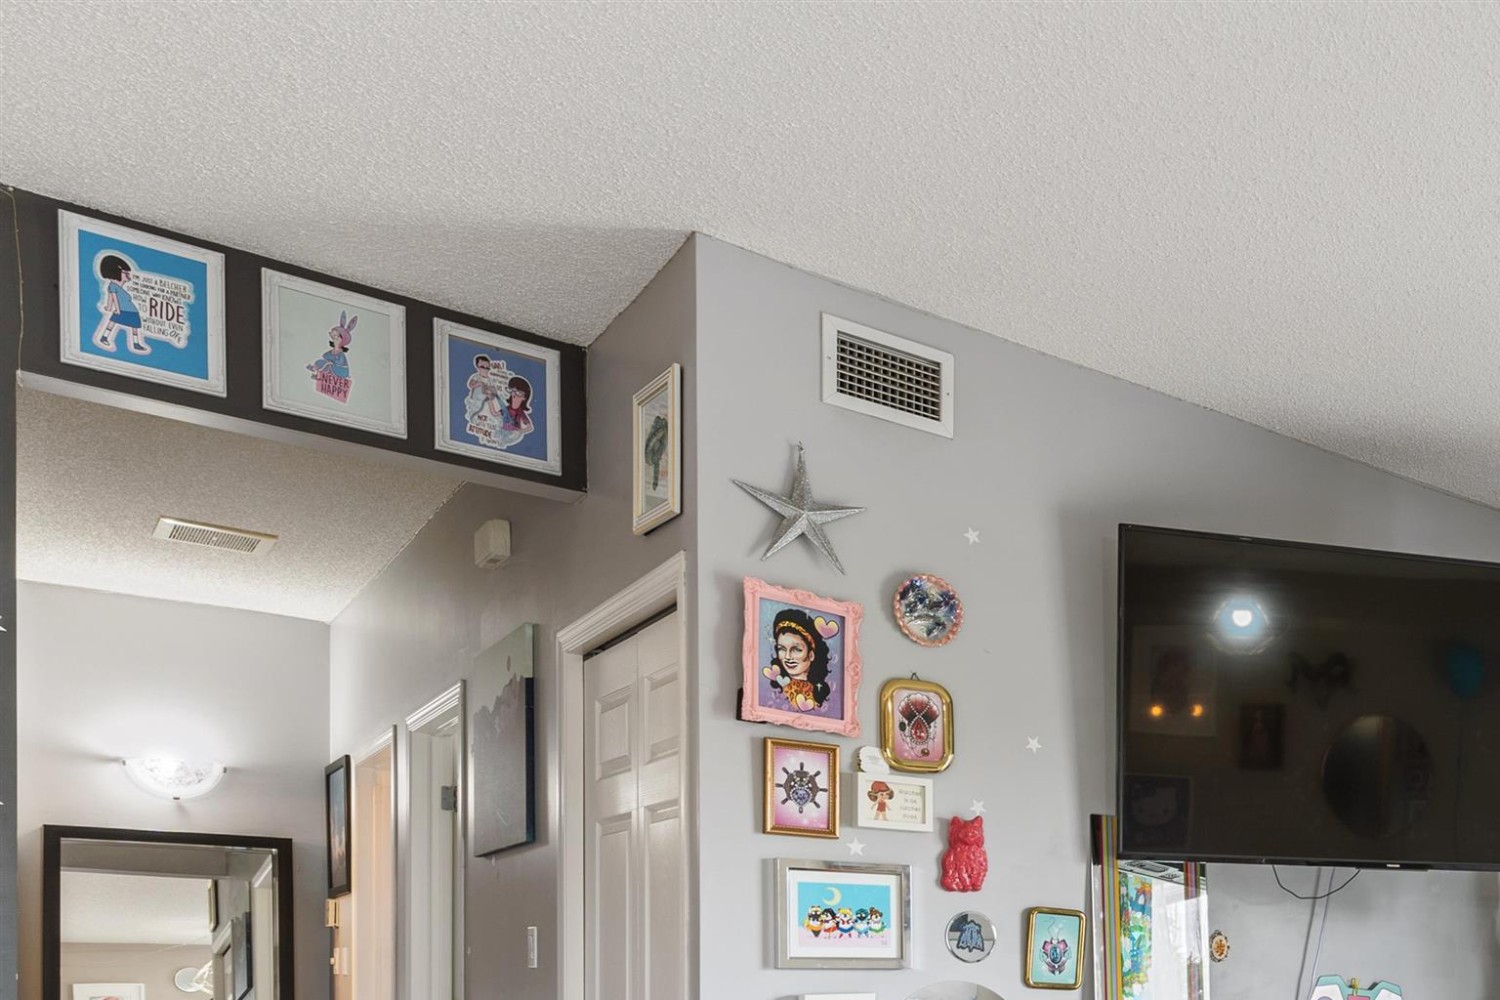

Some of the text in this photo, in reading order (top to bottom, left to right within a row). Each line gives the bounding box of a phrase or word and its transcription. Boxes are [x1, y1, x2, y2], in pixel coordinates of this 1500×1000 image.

[149, 297, 185, 325] RIDE
[142, 324, 169, 337] FALLING
[321, 373, 349, 388] NEVER
[321, 383, 348, 398] HAPPY
